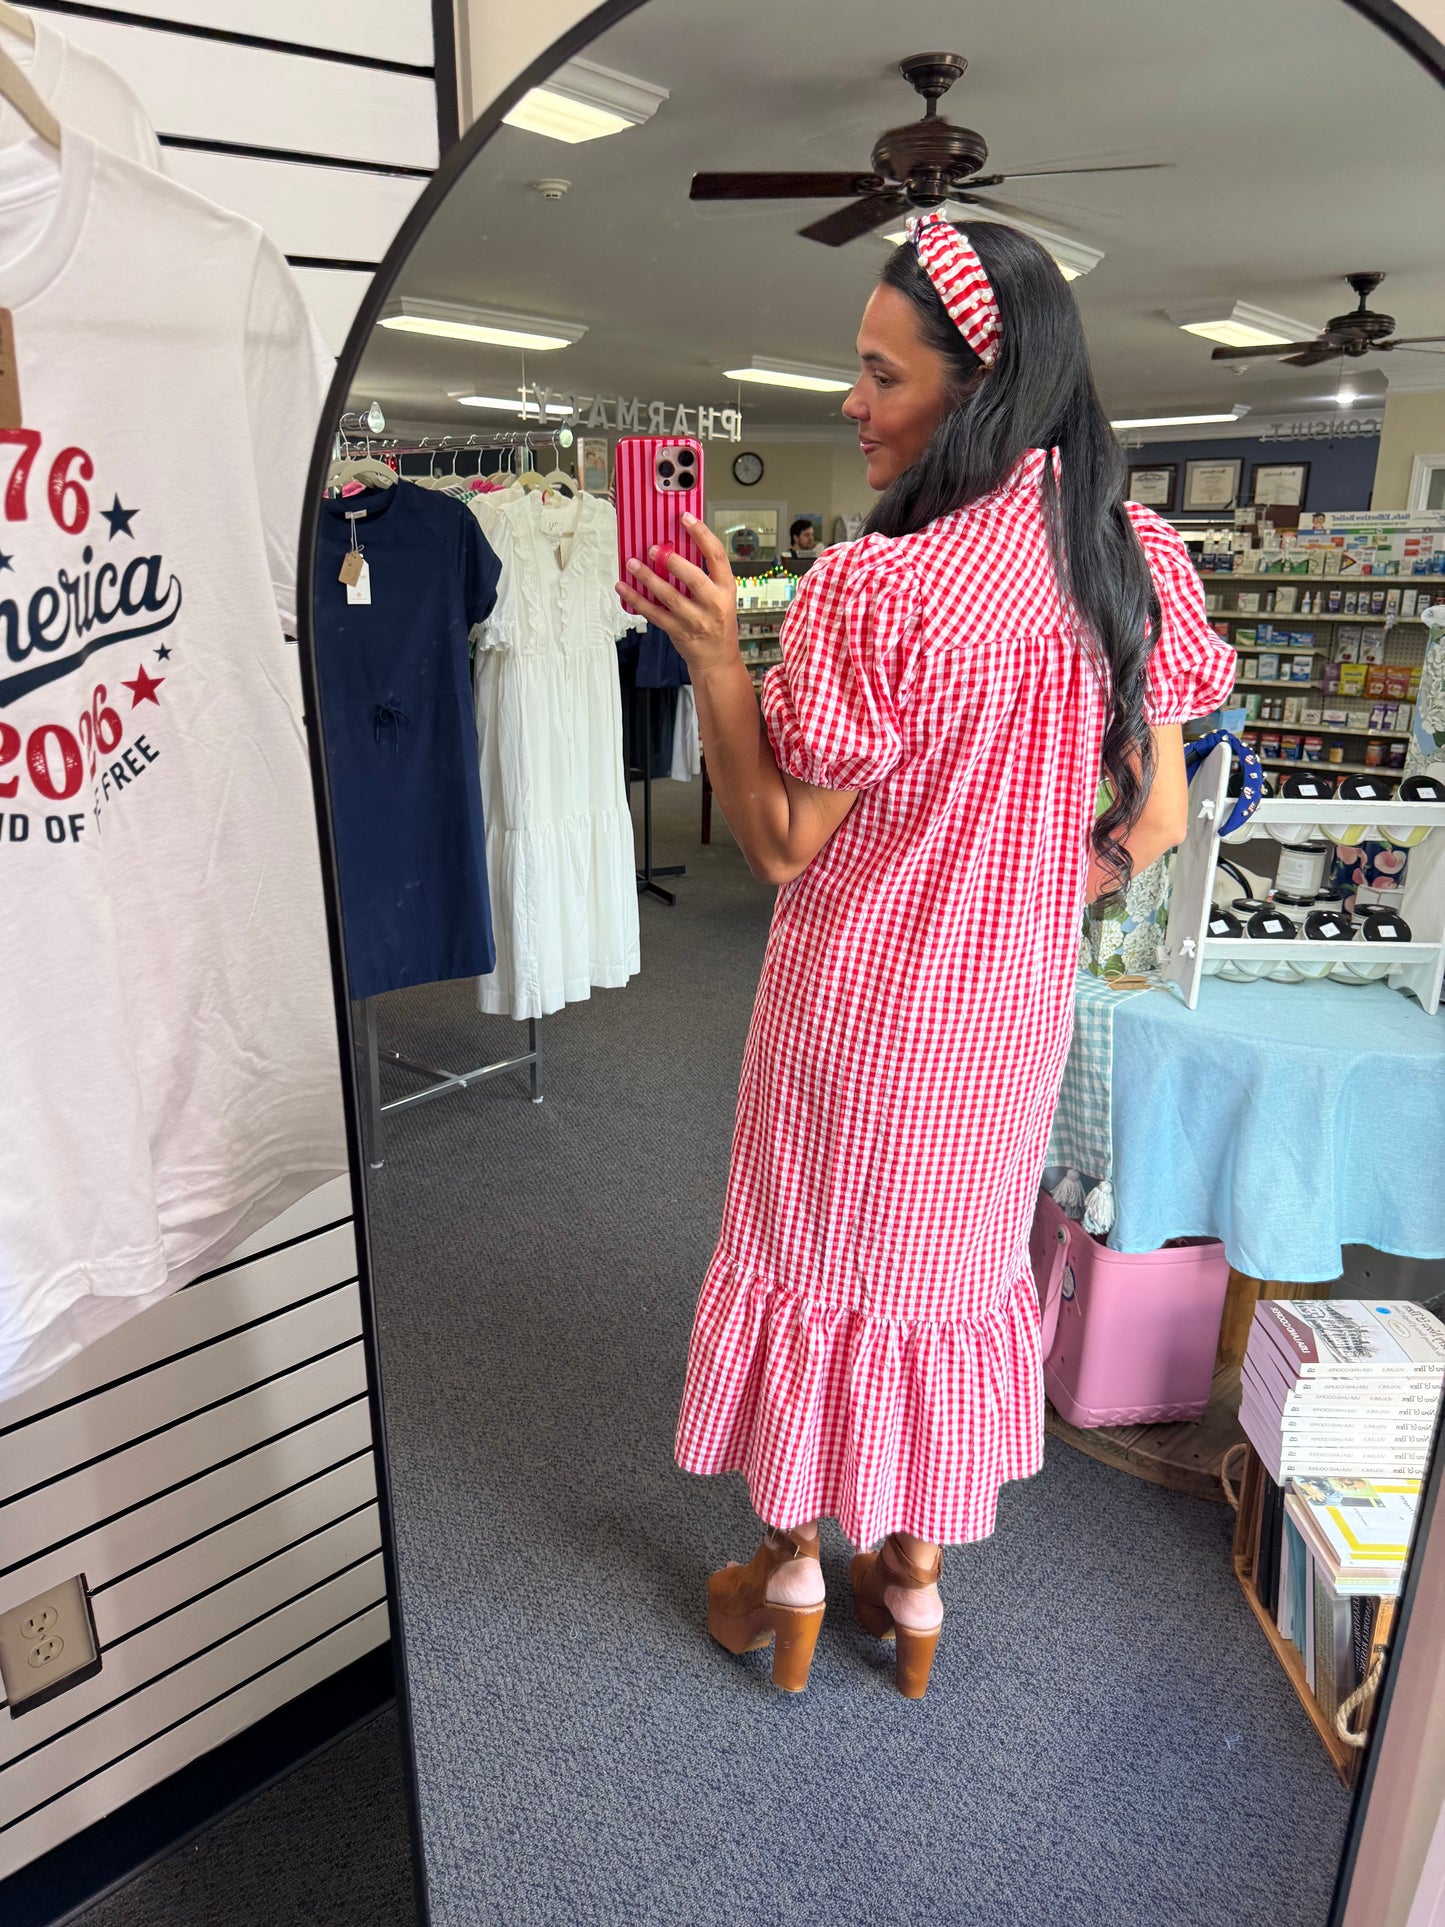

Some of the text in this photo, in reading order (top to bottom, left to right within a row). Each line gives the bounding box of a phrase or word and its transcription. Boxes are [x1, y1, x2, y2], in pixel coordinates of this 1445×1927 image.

[0, 427, 94, 535] 76
[0, 545, 182, 663] erica
[45, 814, 85, 844] OF
[101, 734, 161, 802] FREE
